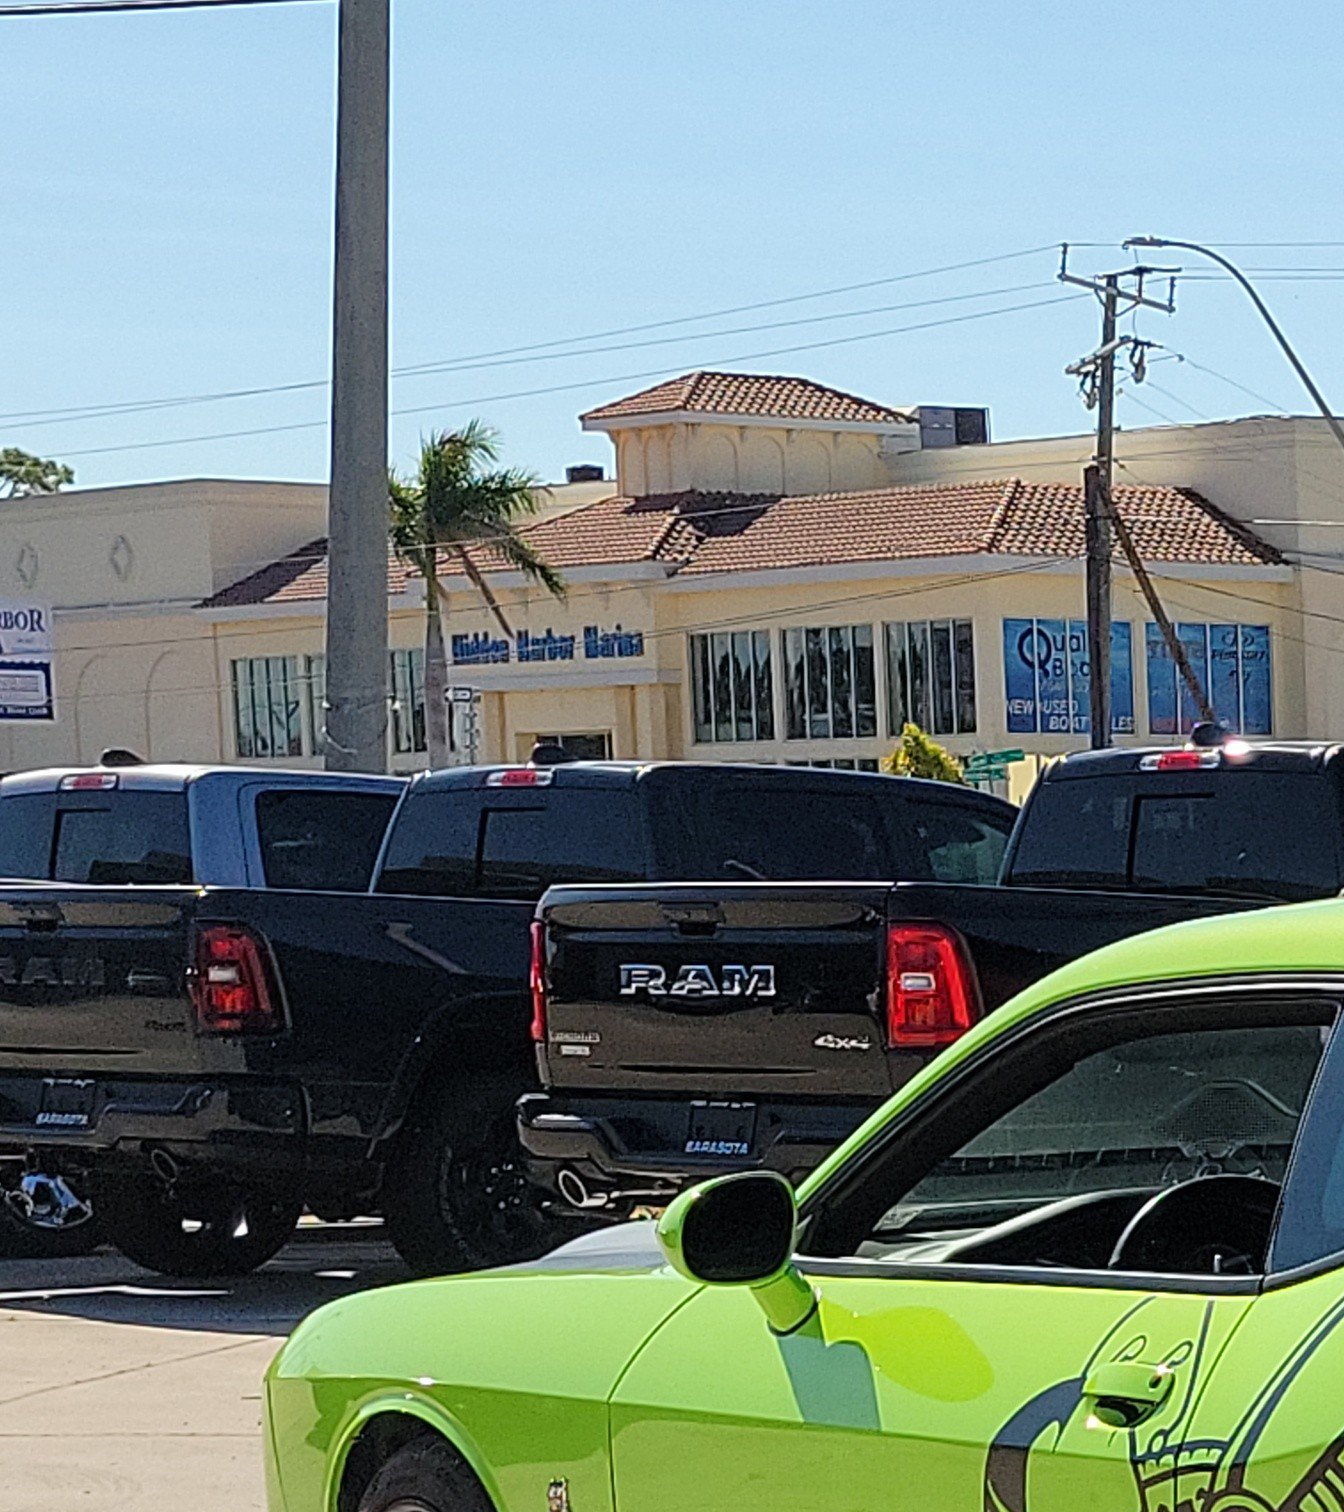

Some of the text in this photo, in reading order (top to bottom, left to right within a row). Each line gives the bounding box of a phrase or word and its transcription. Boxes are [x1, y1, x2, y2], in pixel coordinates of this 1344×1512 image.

[0, 609, 45, 632] BOR
[516, 628, 576, 662] Harbor
[619, 964, 776, 995] RAM
[685, 1140, 749, 1155] SARASOTA
